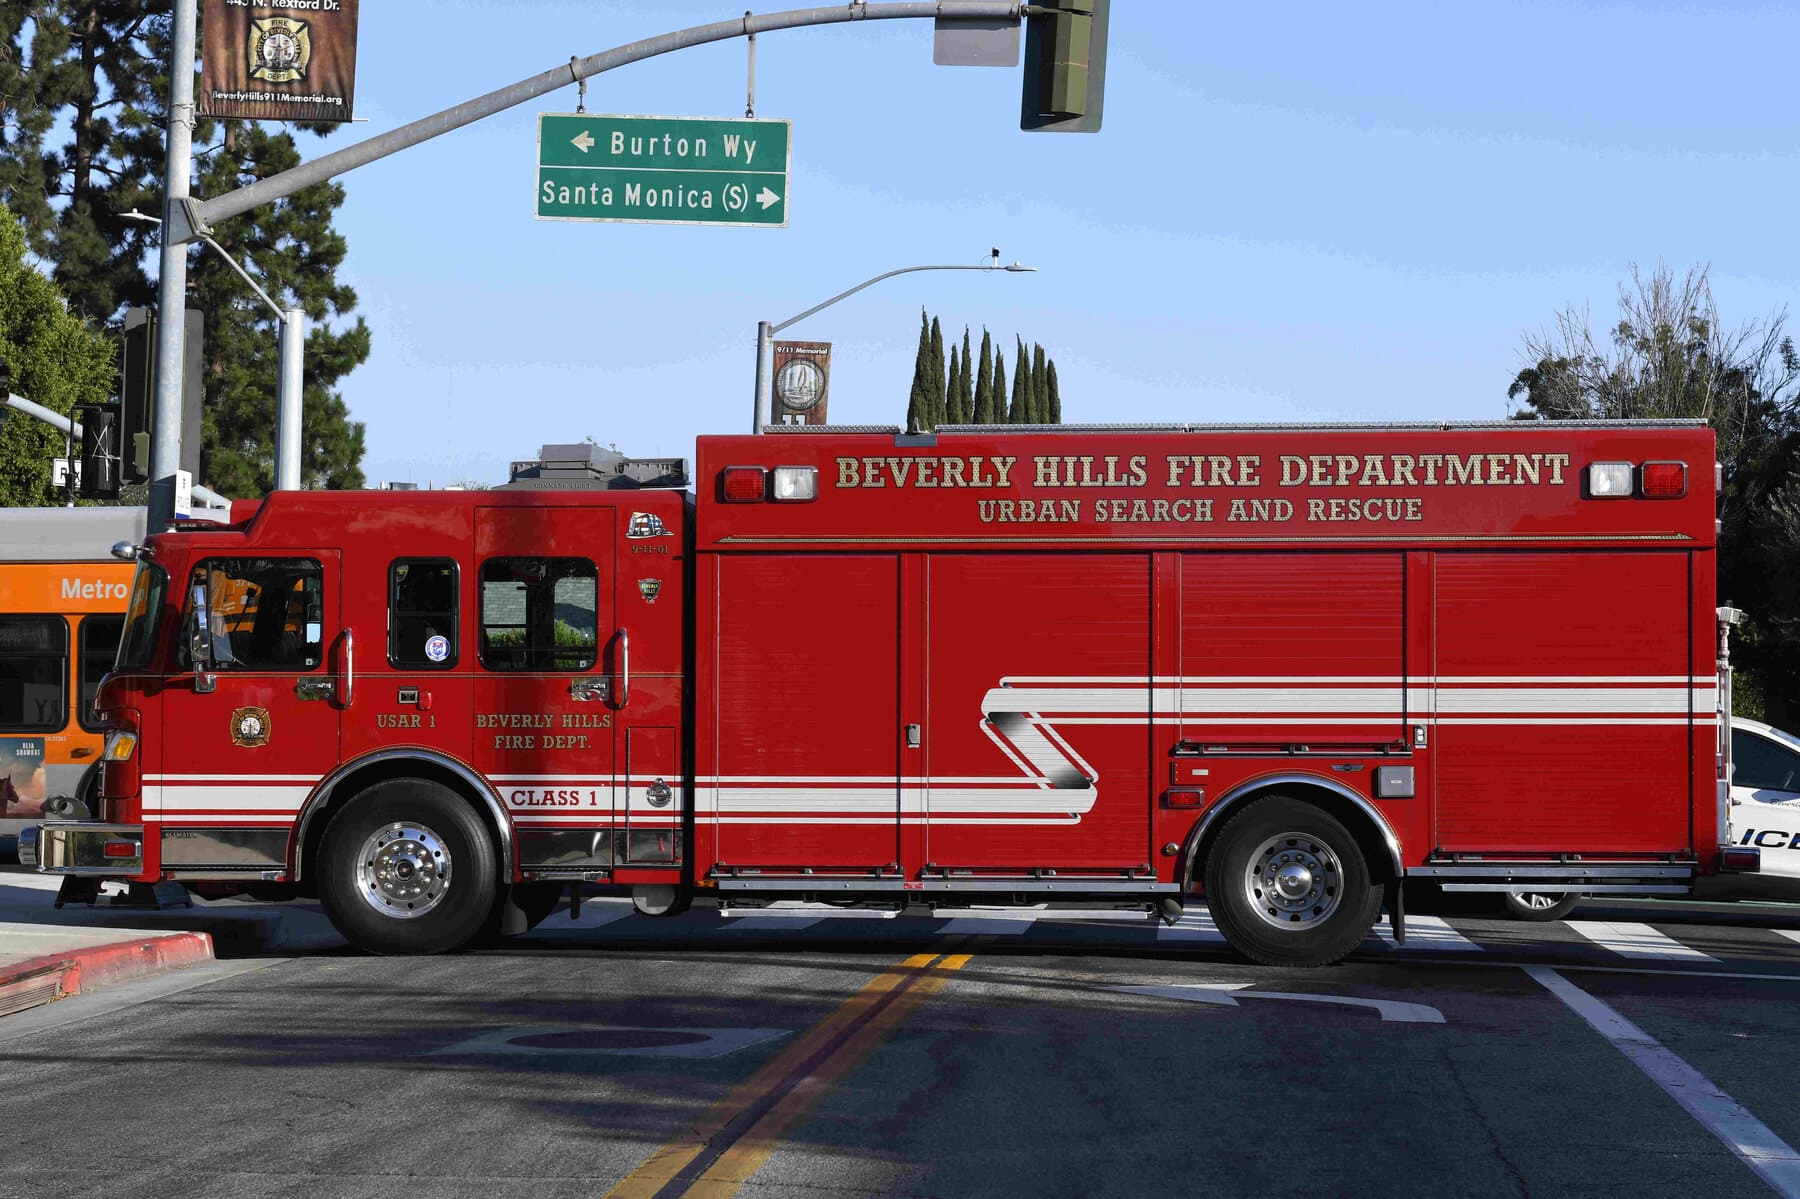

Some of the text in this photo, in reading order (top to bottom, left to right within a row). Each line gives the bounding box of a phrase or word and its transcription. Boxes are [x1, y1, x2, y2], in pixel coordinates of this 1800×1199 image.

[271, 0, 320, 9] Rexford
[323, 0, 340, 10] Dr.
[212, 90, 342, 105] BeverlyHills911Memorial.org
[610, 131, 757, 164] Burton Wy
[542, 180, 748, 213] Santa Monica (S)
[795, 347, 828, 355] Memorial
[835, 453, 1570, 489] BEVERLY HILLS FIRE DEPARTMENT
[977, 498, 1423, 523] URBAN SEARCH AND RESCUE
[632, 544, 669, 554] 9-11-01
[61, 578, 128, 600] Metro
[376, 714, 437, 728] USAR 1
[476, 714, 612, 728] BEVERLY HILLS
[494, 735, 593, 749] FIRE DEPT.
[510, 790, 598, 806] CLASS 1
